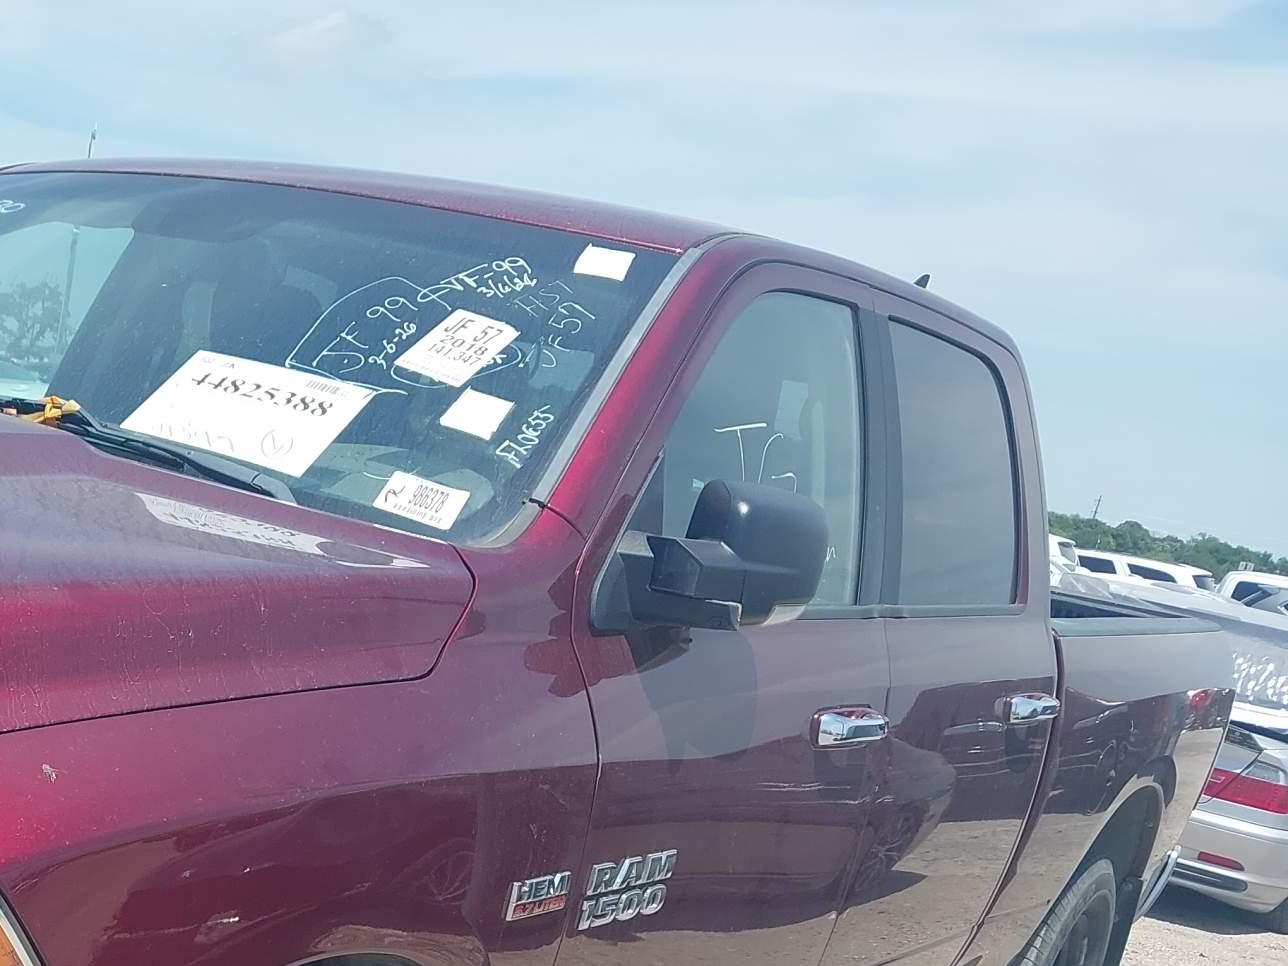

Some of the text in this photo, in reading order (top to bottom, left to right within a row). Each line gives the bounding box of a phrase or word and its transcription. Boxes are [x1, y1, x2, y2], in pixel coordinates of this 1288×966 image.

[366, 296, 419, 322] 99
[439, 334, 489, 357] 2018
[443, 316, 505, 345] JF 57
[191, 372, 334, 418] 44825388
[586, 849, 678, 896] RAM
[576, 883, 668, 931] 1500
